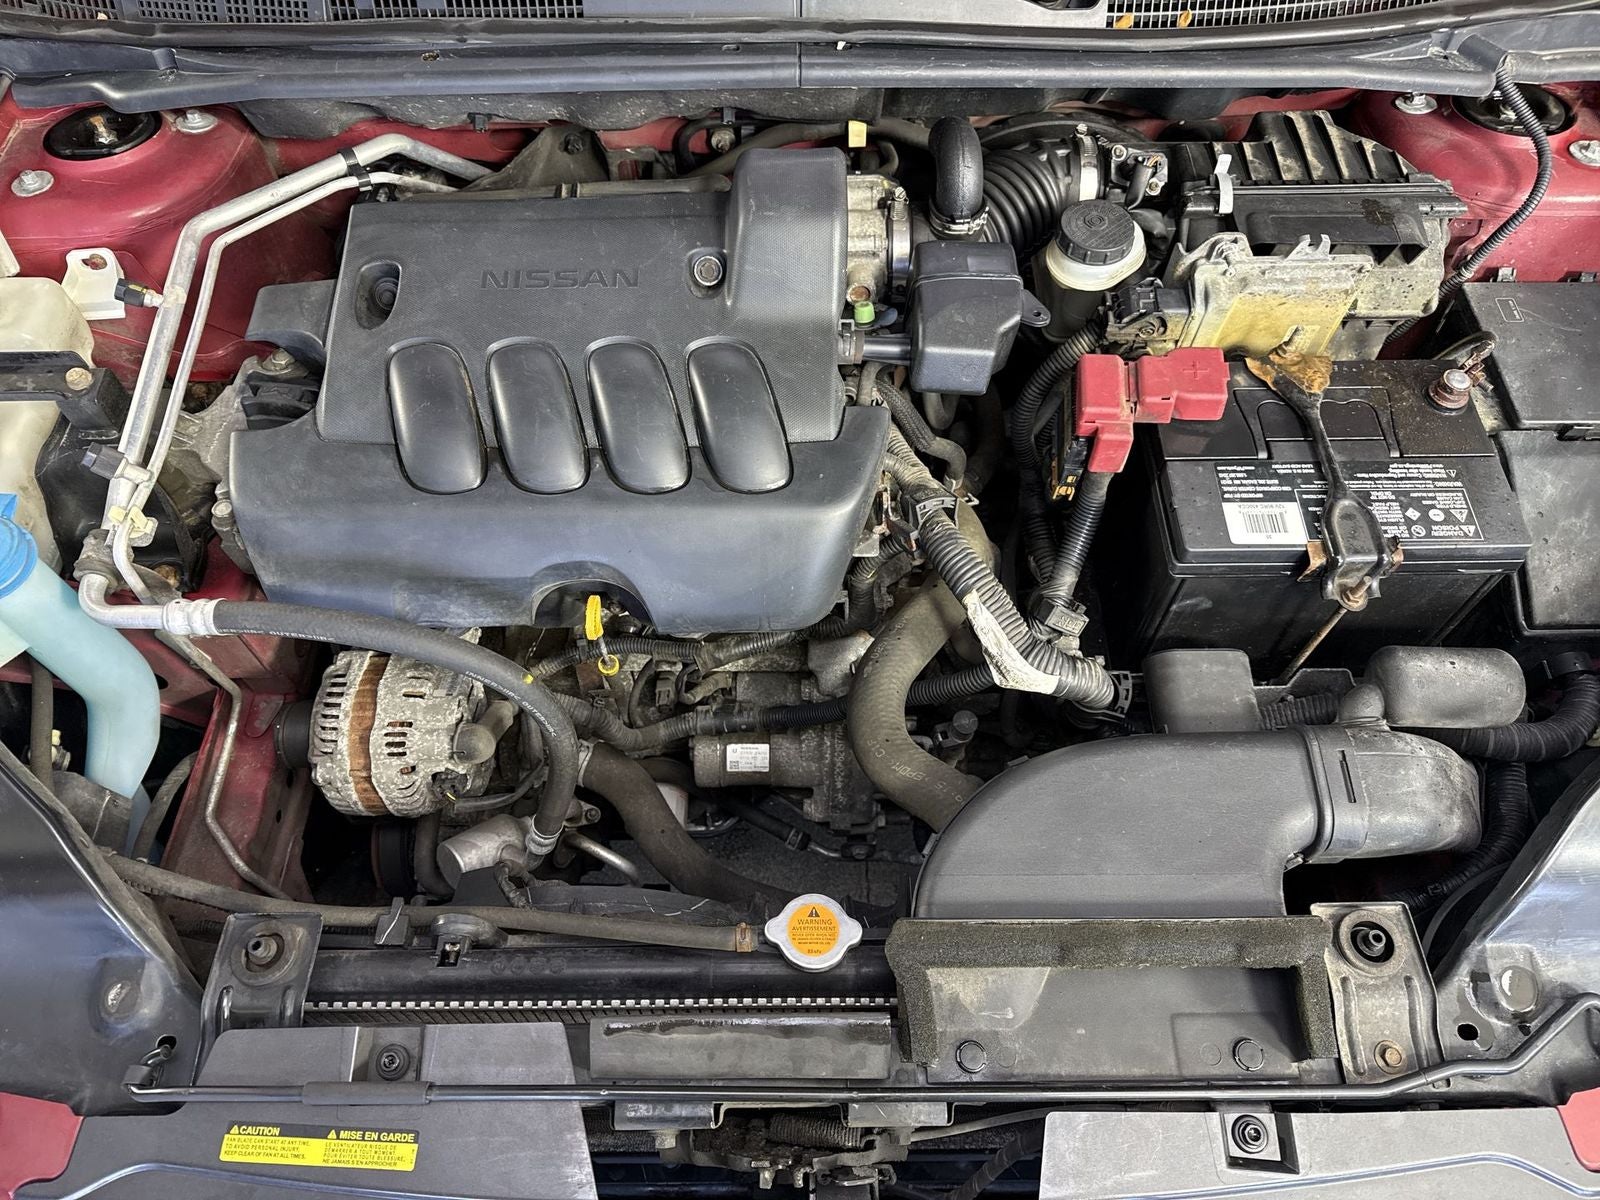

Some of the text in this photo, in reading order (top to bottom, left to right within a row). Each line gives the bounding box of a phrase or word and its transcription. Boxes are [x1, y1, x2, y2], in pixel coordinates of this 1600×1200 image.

[481, 270, 640, 289] NISSAN
[240, 1126, 280, 1135] CAUTION
[340, 1130, 415, 1142] MISE EN GARDE
